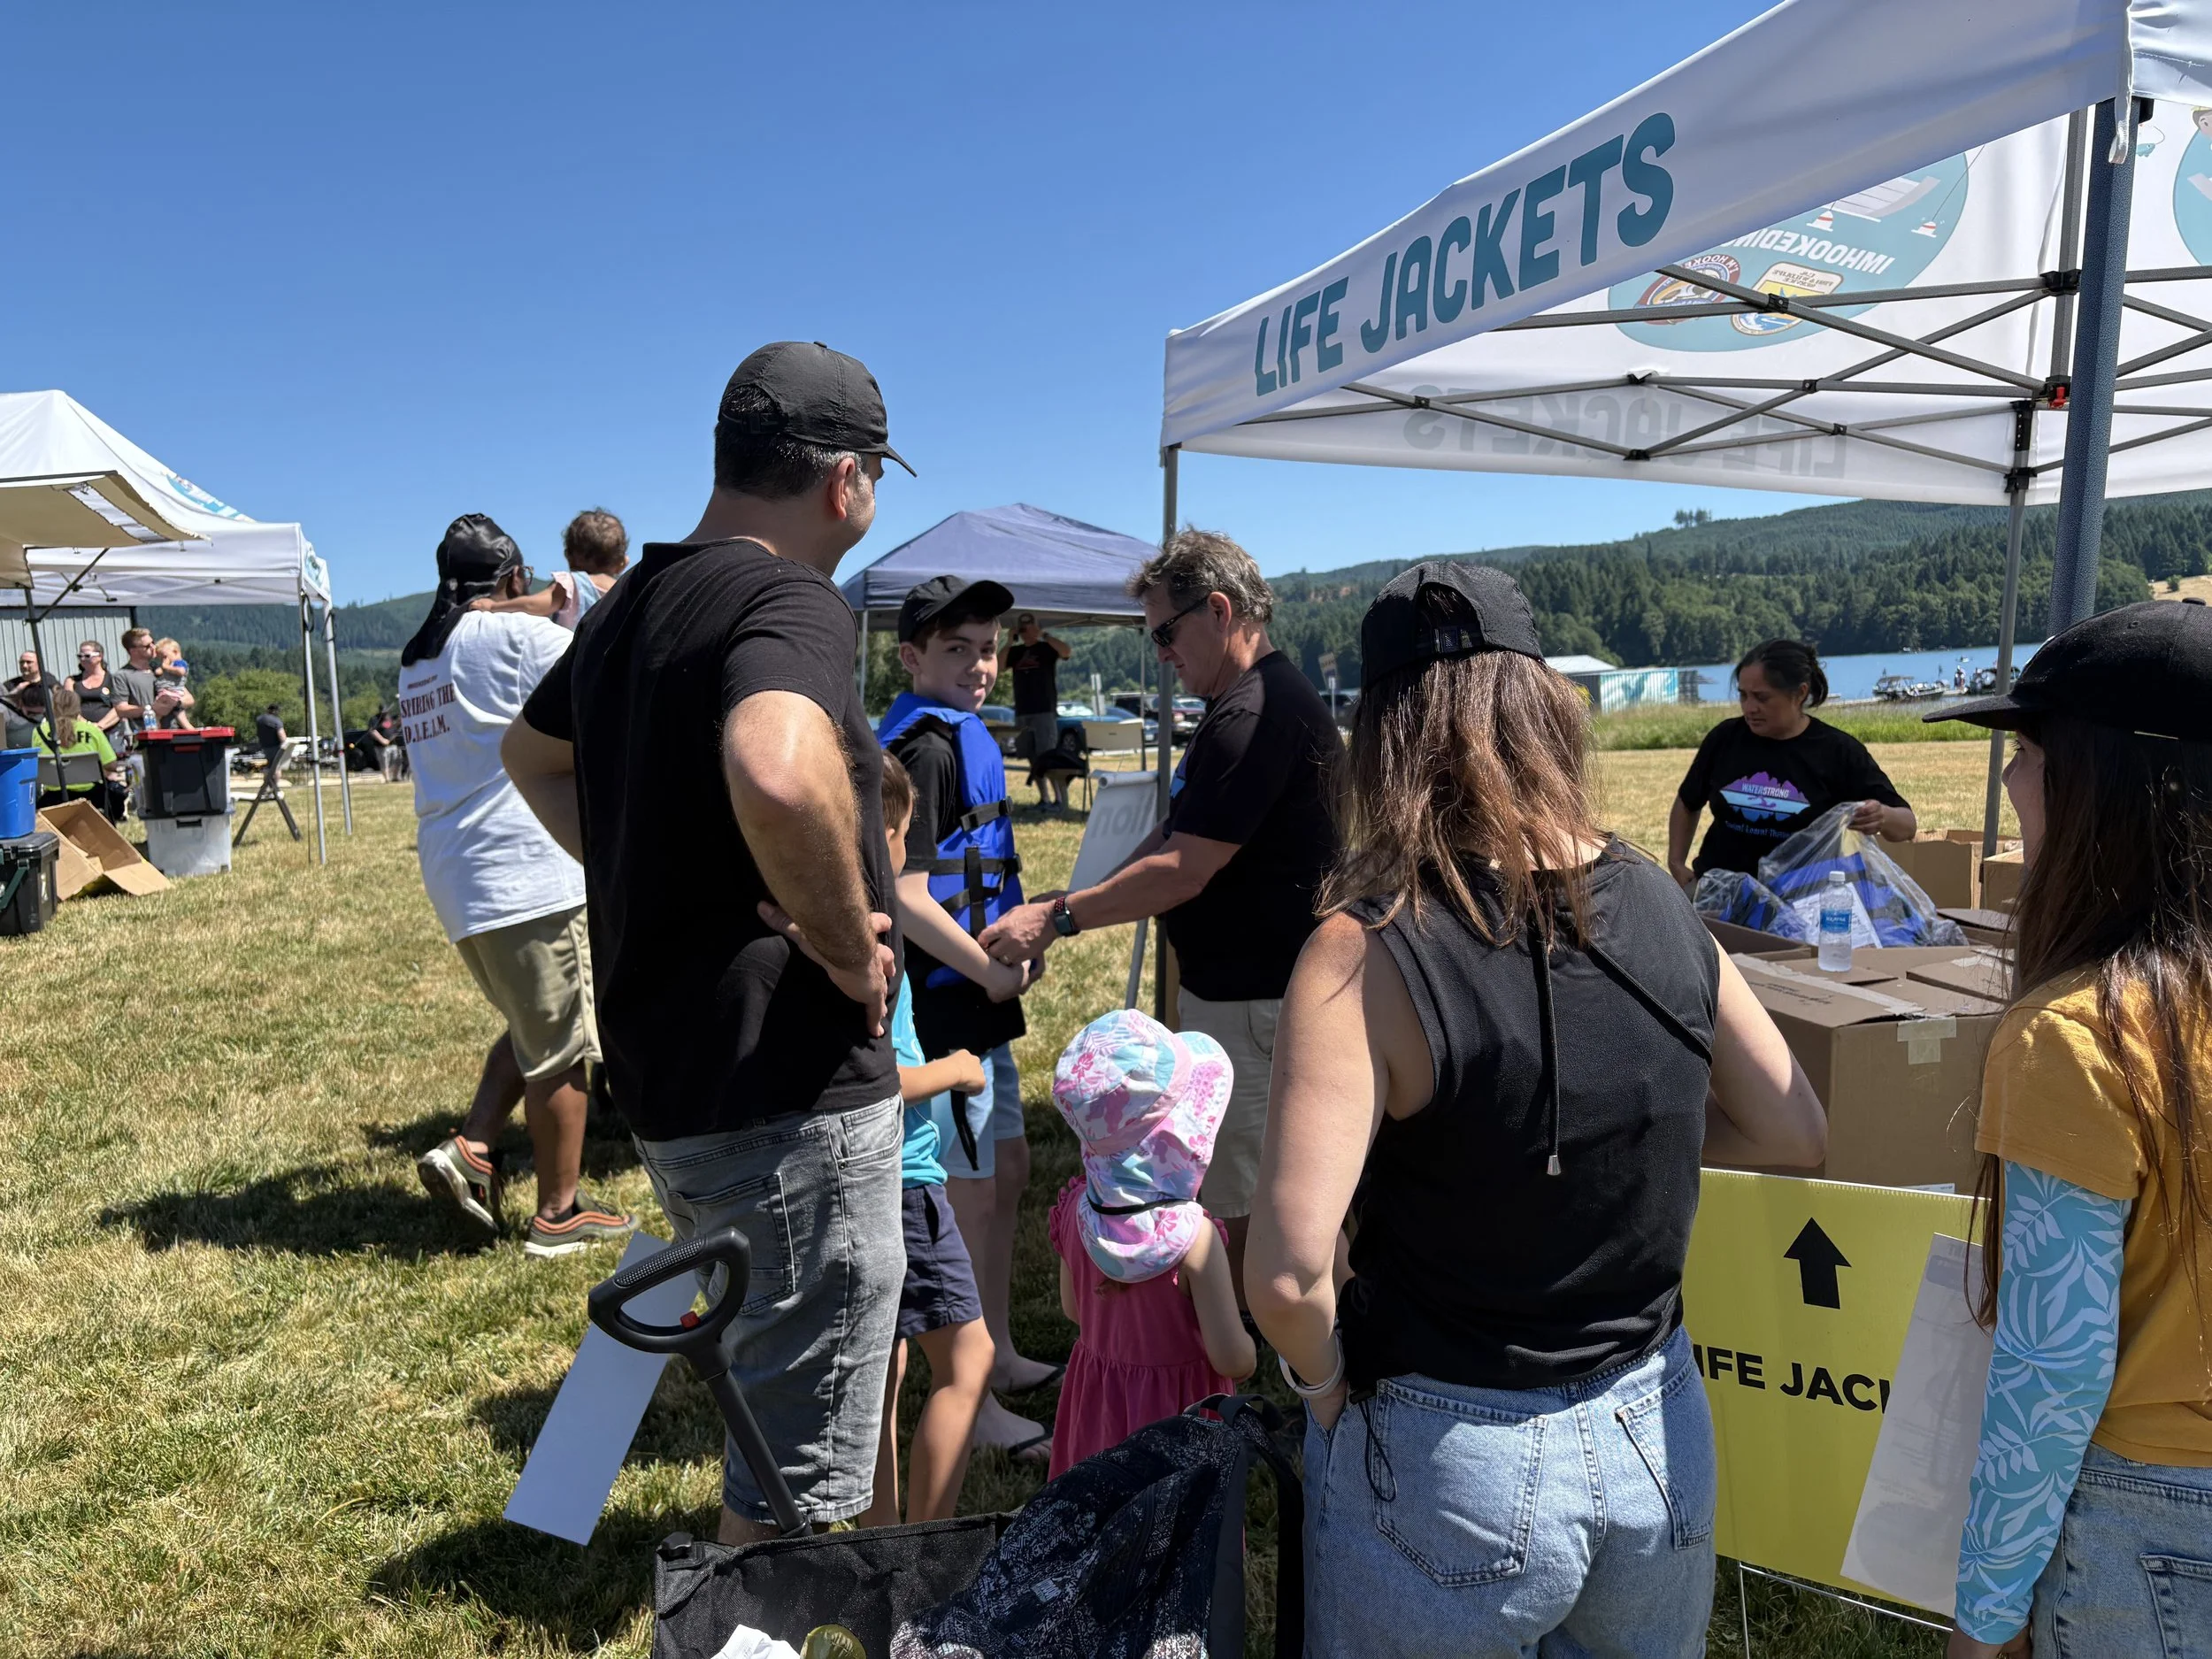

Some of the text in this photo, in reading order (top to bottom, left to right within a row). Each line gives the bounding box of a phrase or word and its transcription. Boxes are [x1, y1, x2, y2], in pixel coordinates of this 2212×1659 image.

[1255, 111, 1677, 397] LIFE JACKETS
[1741, 782, 1790, 798] WATERSTRONG
